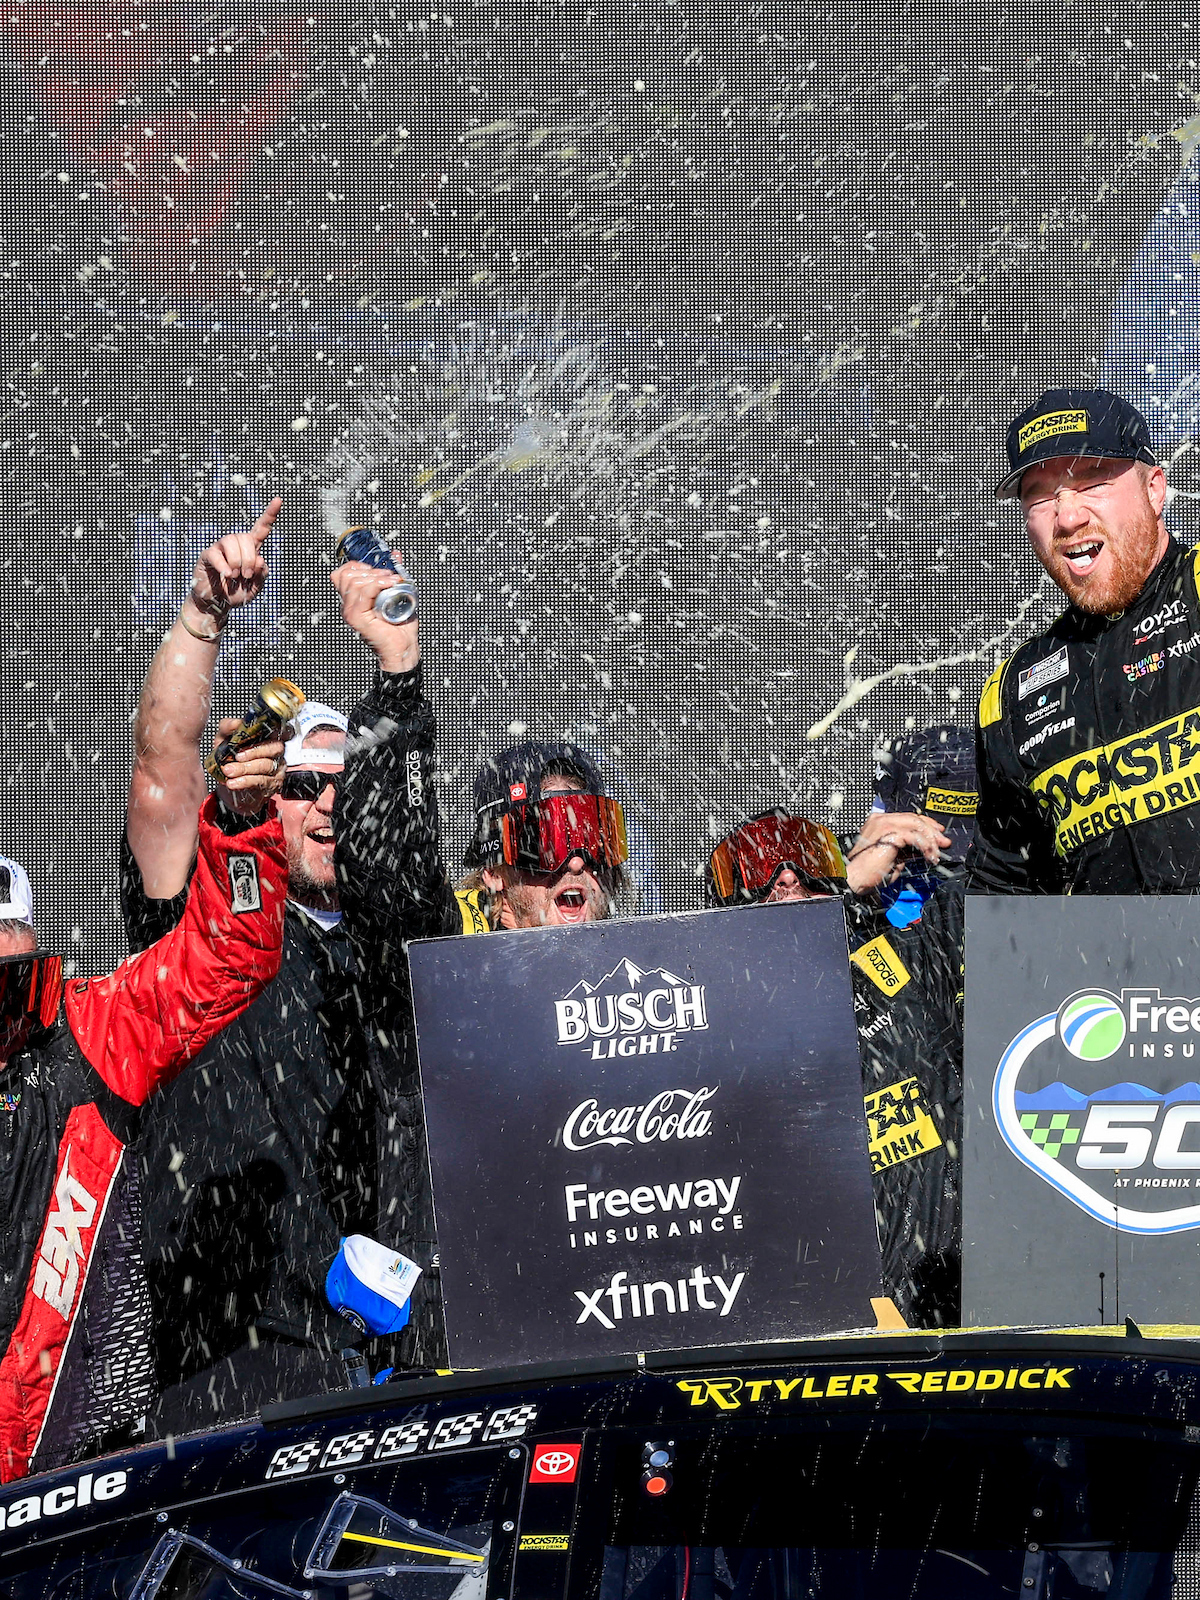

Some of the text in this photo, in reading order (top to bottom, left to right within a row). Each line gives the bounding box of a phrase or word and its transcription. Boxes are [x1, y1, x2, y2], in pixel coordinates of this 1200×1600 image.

[1020, 412, 1085, 443] ROCKSTAR
[1024, 423, 1079, 448] ENERGY DRINK
[1034, 652, 1062, 674] NASCAR
[1040, 667, 1062, 682] SERIES
[1122, 650, 1165, 674] CHUMBA
[1127, 660, 1165, 682] CASINO
[1025, 699, 1060, 721] Comparion
[1019, 716, 1076, 756] GOODYEAR
[405, 749, 423, 807] sparco
[1058, 797, 1138, 851] ENERGY
[866, 946, 900, 988] sparco
[553, 984, 709, 1046] BUSCH
[590, 1031, 678, 1060] LIGHT
[562, 1085, 720, 1151] Coca-Cola
[870, 1128, 925, 1172] RINK
[564, 1175, 742, 1222] Freeway
[1113, 1178, 1131, 1188] AT
[1134, 1178, 1191, 1188] PHOENIX
[569, 1214, 744, 1248] INSURANCE
[573, 1265, 746, 1329] xfinity
[744, 1373, 879, 1402] TYLER
[885, 1367, 1075, 1394] REDDICK
[520, 1536, 570, 1545] ROCKSTAR
